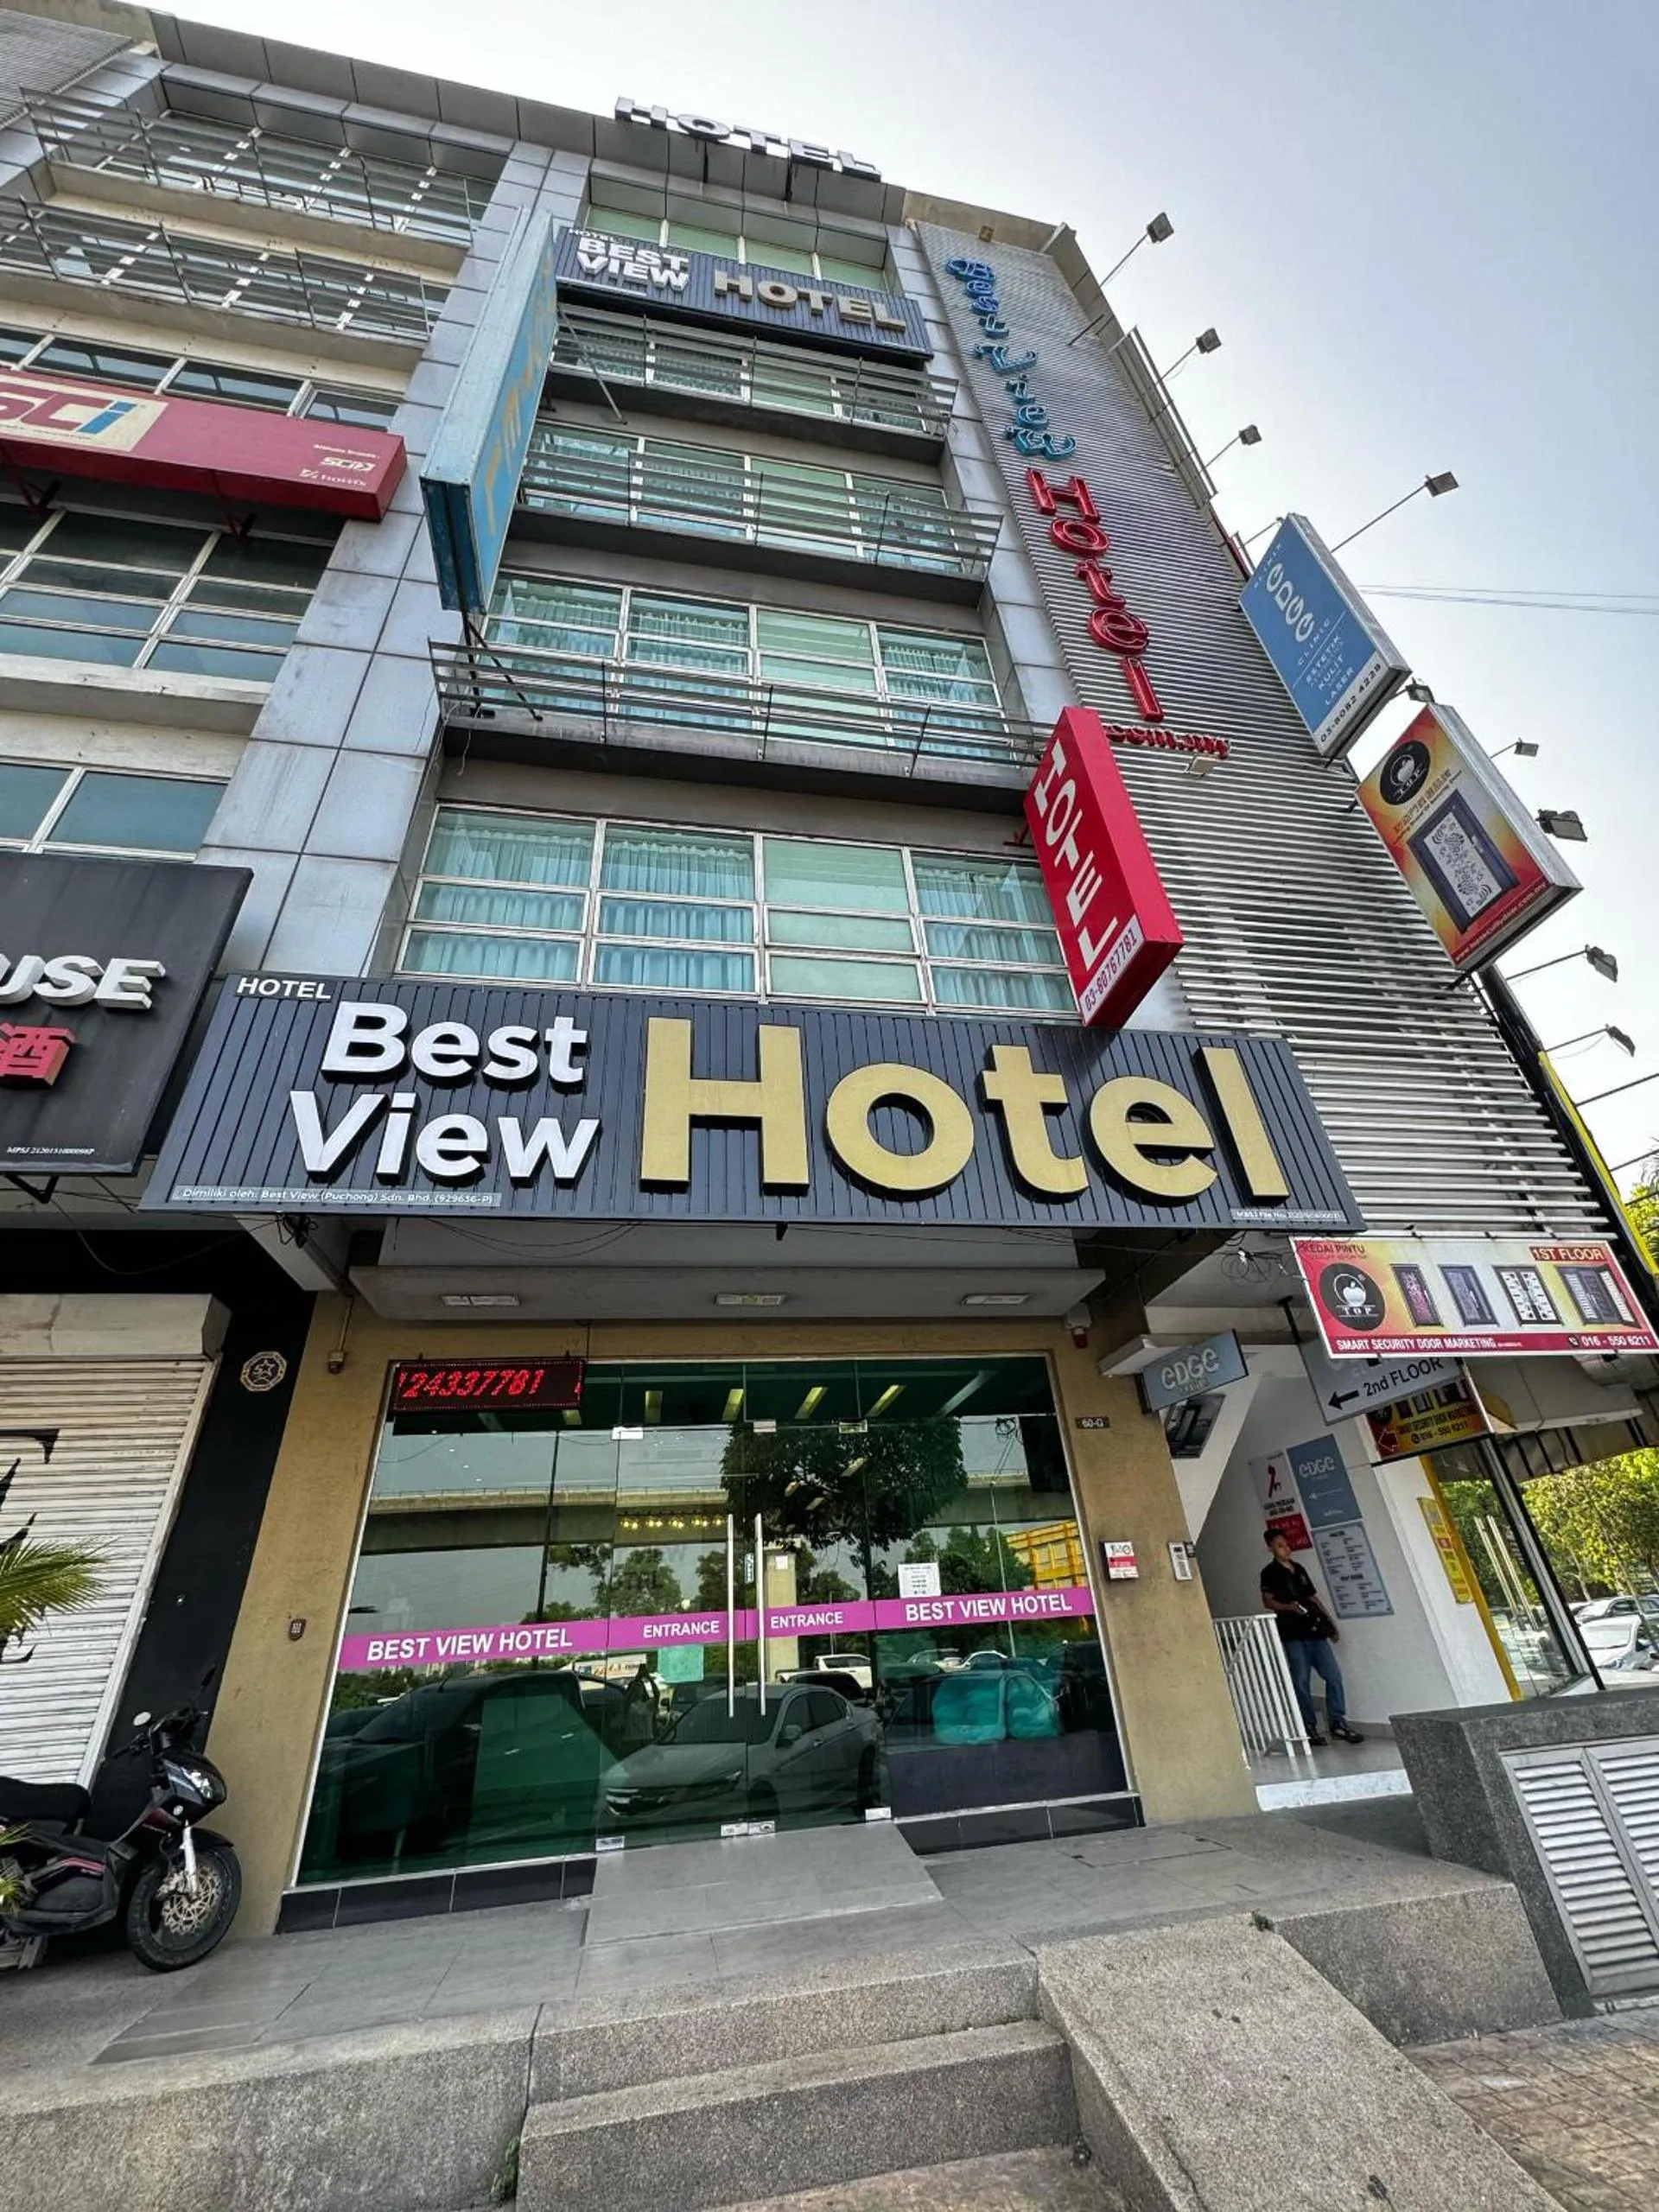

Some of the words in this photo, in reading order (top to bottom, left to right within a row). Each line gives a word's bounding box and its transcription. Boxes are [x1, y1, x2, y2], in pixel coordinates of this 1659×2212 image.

[614, 95, 881, 182] HOTEL
[578, 237, 690, 270] BEST
[577, 251, 690, 292] VIEW
[714, 270, 906, 333] HOTEL
[1026, 467, 1164, 722] Hotel
[1297, 618, 1331, 666] CLINIC
[1033, 739, 1118, 971] HOTEL
[237, 976, 332, 1000] HOTEL
[321, 1000, 588, 1085] Best
[639, 1017, 1291, 1198] Hotel
[289, 1090, 601, 1180] View
[183, 1189, 226, 1200] Dimiliki
[261, 1190, 287, 1200] Best
[289, 1191, 319, 1200] View
[321, 1191, 378, 1203] (Puchong)
[1336, 1243, 1365, 1254] PINTU
[1532, 1248, 1557, 1261] 1ST
[1559, 1248, 1605, 1261] FLOOR
[1342, 1306, 1372, 1315] TOP
[1337, 1339, 1370, 1351] SMART
[1371, 1338, 1415, 1351] SECURITY
[1417, 1338, 1444, 1350] DOOR
[1445, 1337, 1497, 1350] MARKETING
[1581, 1336, 1602, 1347] 016
[1609, 1336, 1627, 1346] 550
[1628, 1335, 1652, 1346] 6211
[1363, 1375, 1389, 1397] 2nd
[1390, 1357, 1446, 1387] FLOOR
[770, 1610, 844, 1630] ENTRANCE
[905, 1600, 955, 1624] BEST
[957, 1597, 1007, 1619] VIEW
[1010, 1593, 1072, 1615] HOTEL
[367, 1637, 431, 1662] BEST
[435, 1633, 495, 1657] VIEW
[499, 1628, 574, 1652] HOTEL
[643, 1619, 721, 1639] ENTRANCE
